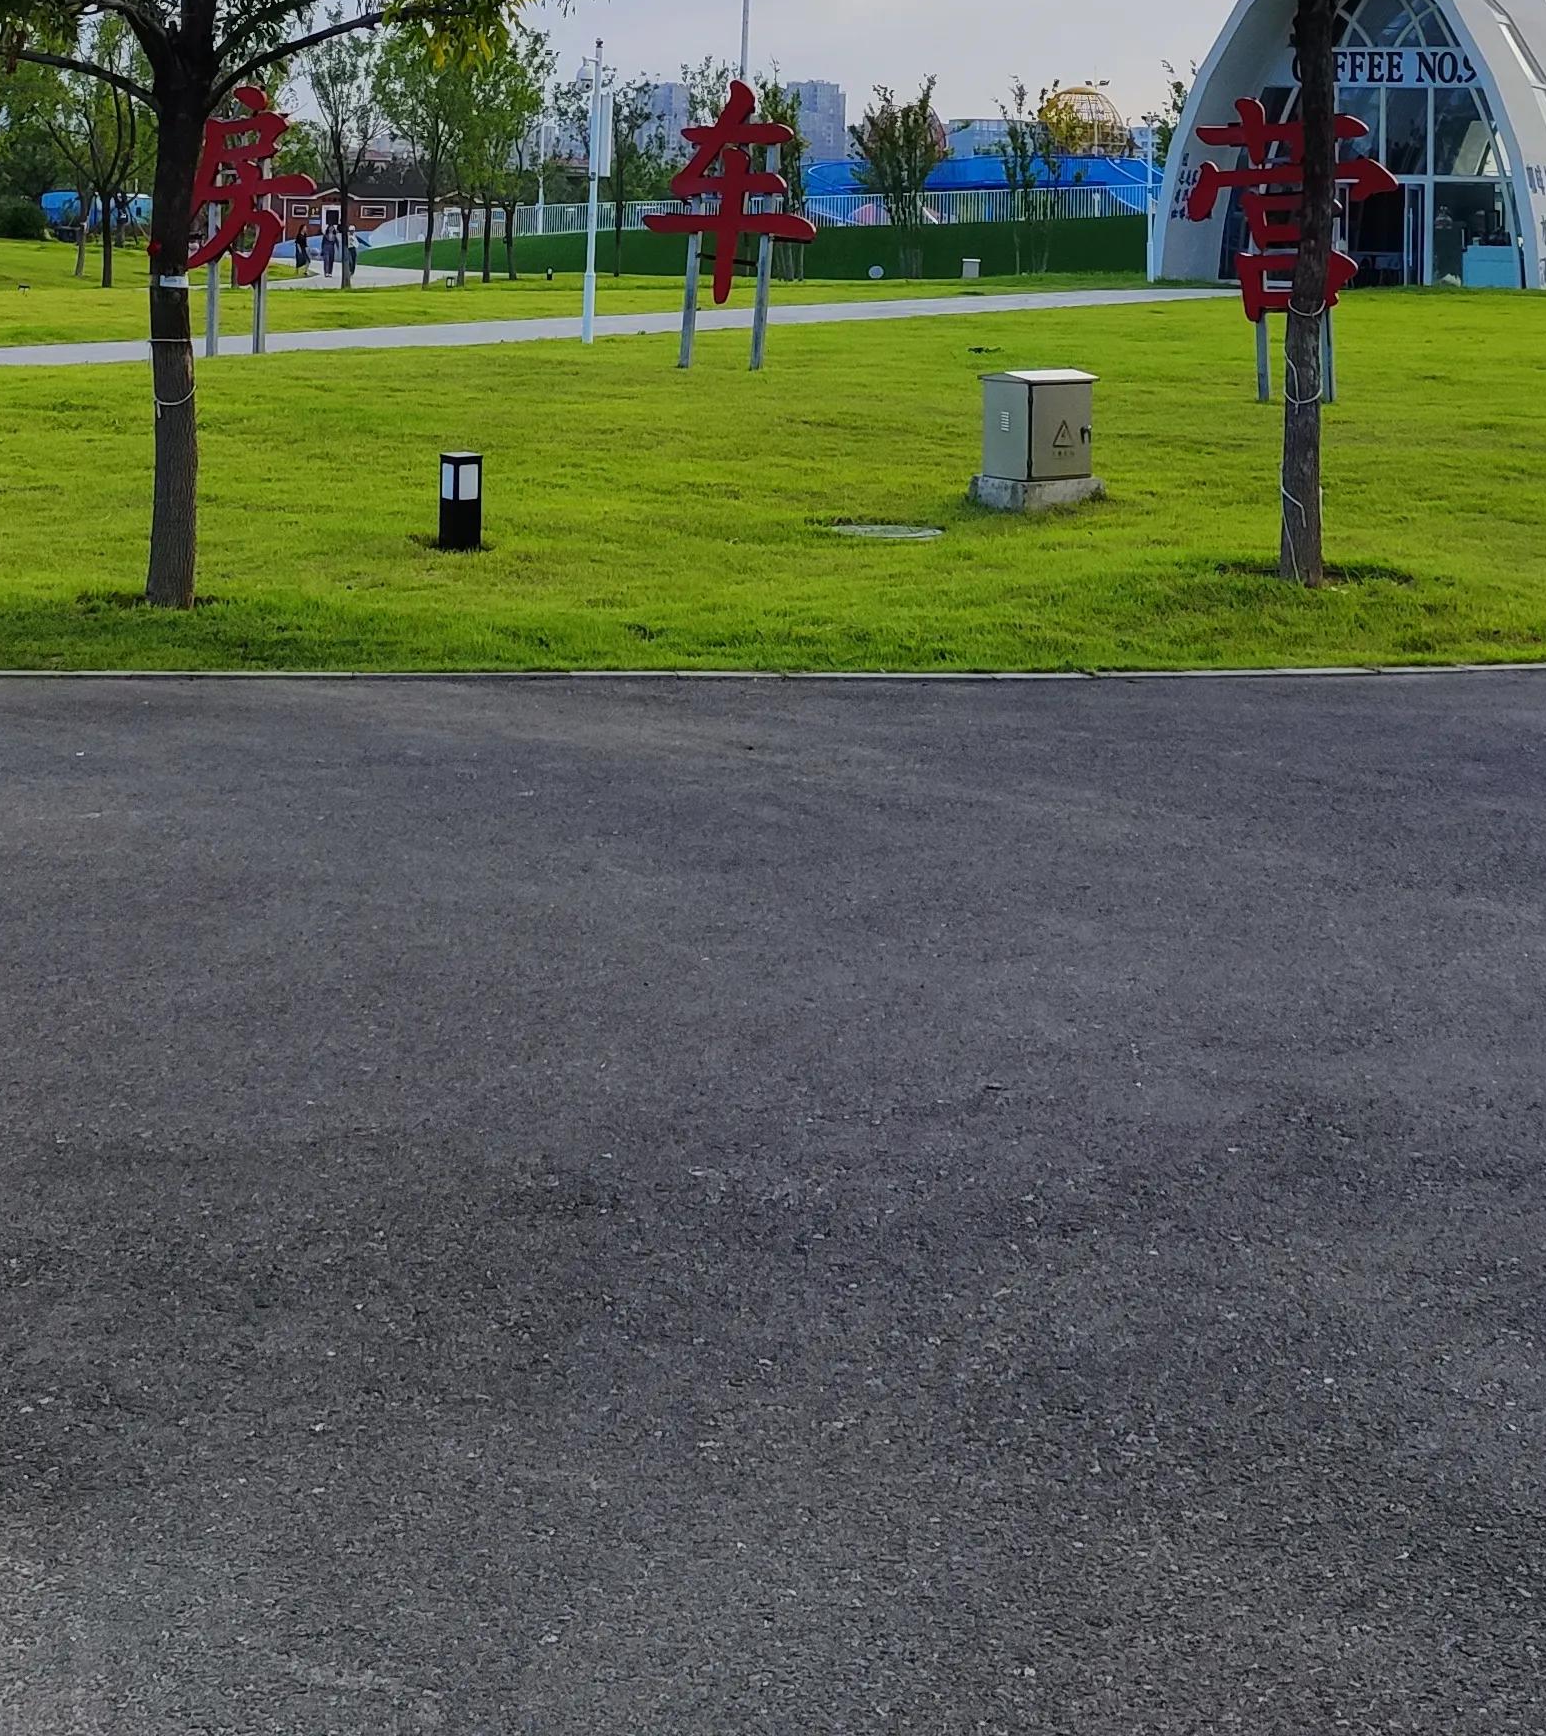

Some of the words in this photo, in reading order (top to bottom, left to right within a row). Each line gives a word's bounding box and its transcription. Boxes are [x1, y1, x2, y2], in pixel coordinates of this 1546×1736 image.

[187, 85, 317, 286] 房
[643, 79, 817, 305] 车
[1187, 96, 1399, 323] 营
